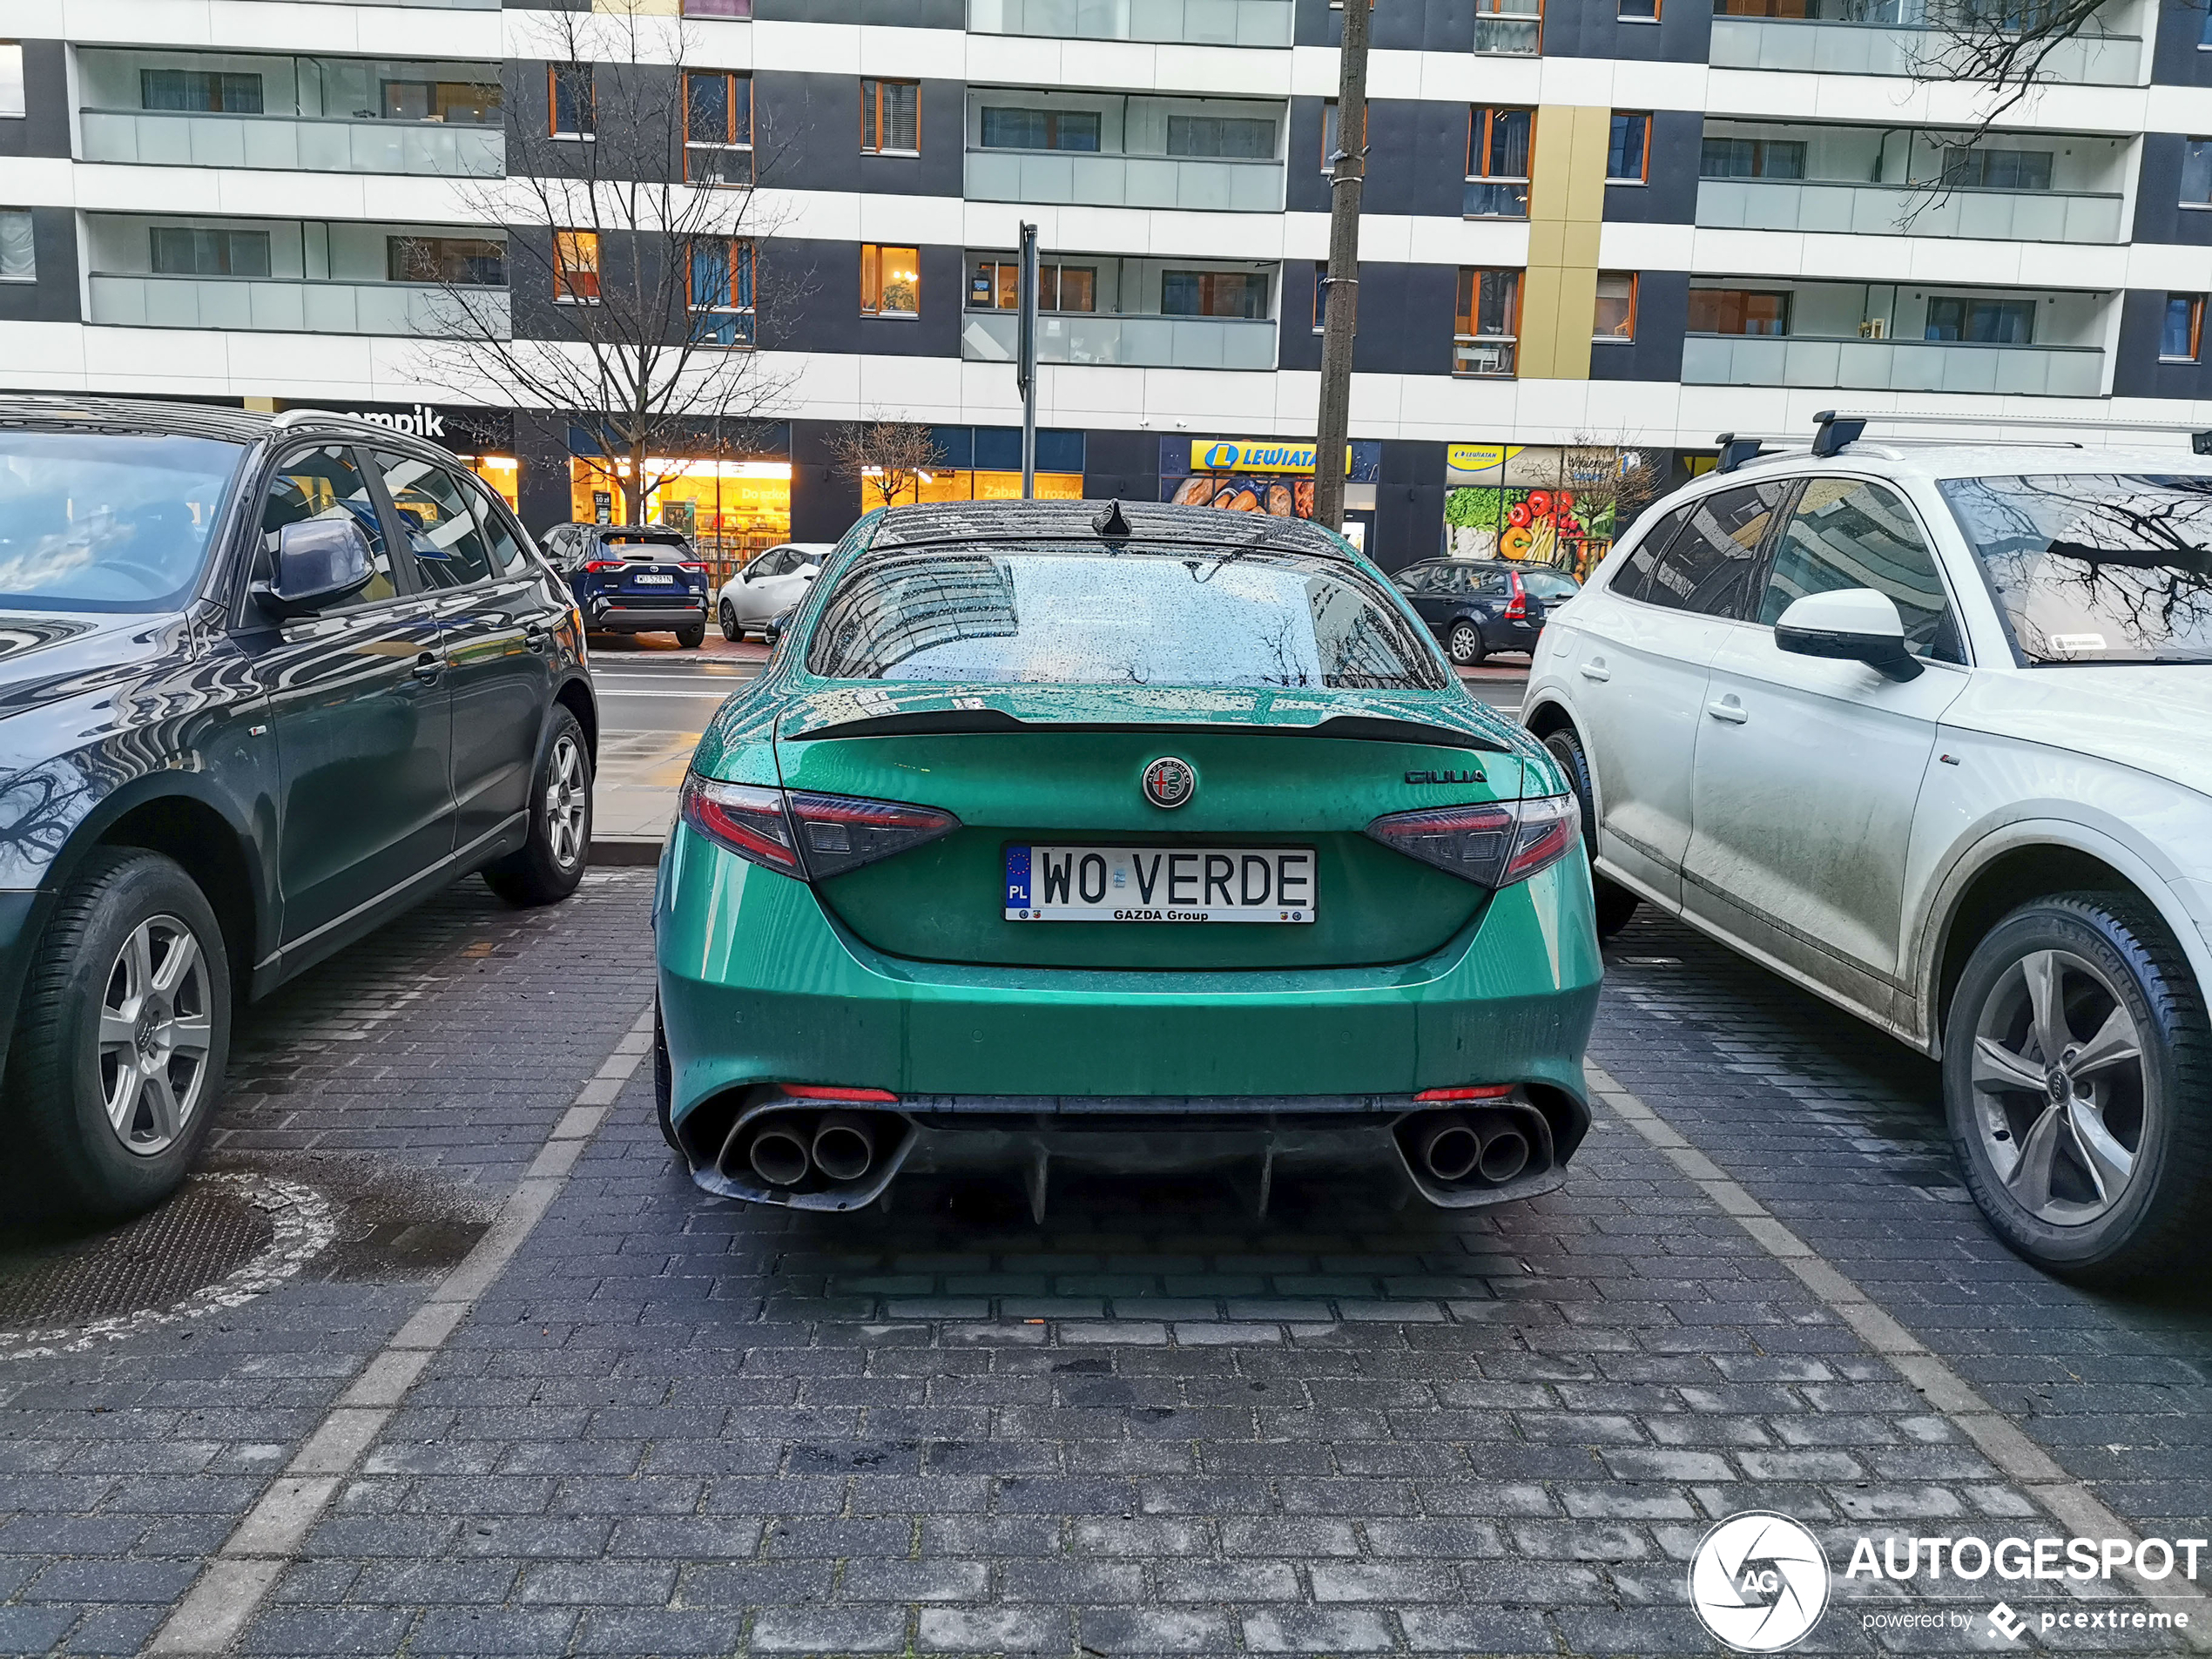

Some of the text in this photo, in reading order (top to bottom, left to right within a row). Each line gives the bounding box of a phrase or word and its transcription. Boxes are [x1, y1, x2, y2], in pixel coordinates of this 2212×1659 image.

[1243, 448, 1317, 466] LEWIATA
[742, 488, 759, 499] Do
[984, 486, 1035, 498] Zaba
[1148, 761, 1190, 785] ALFA ROMEO
[1405, 770, 1487, 784] GIULIA
[1042, 852, 1308, 907] WO VERDE
[1008, 885, 1028, 900] PL
[1113, 909, 1209, 922] GAZDA Group
